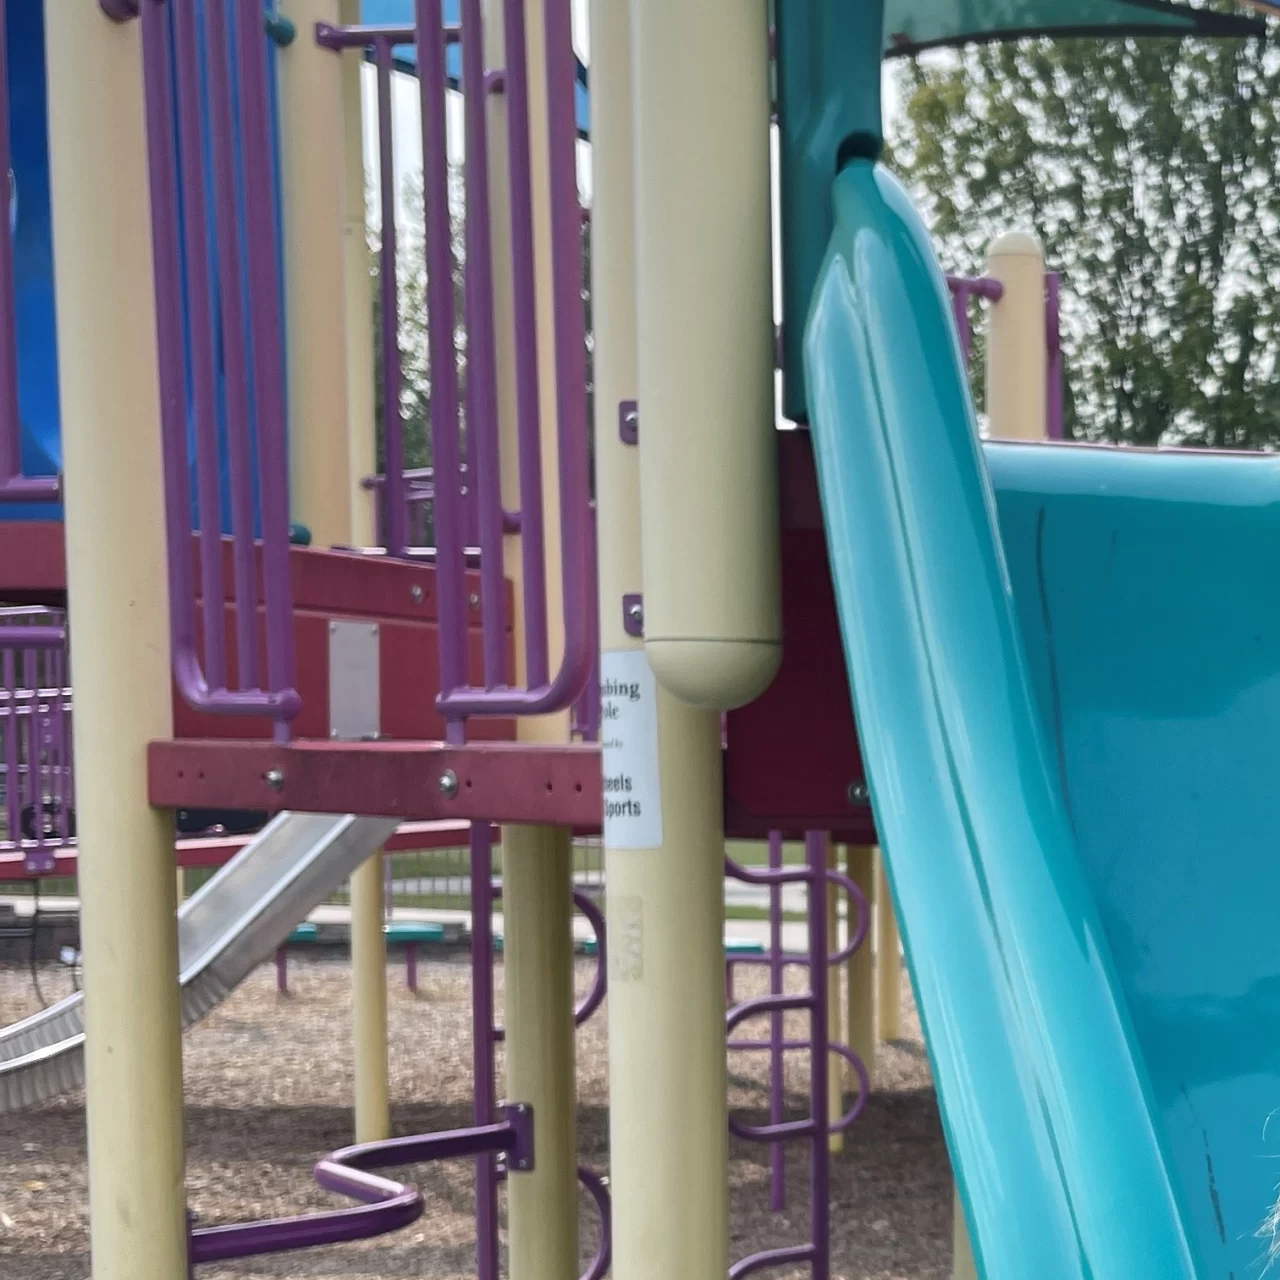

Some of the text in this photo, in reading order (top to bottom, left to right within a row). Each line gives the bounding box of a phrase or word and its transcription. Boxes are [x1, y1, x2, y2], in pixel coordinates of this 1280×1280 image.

[602, 678, 641, 702] bing
[603, 701, 619, 719] ole
[604, 774, 632, 792] eels
